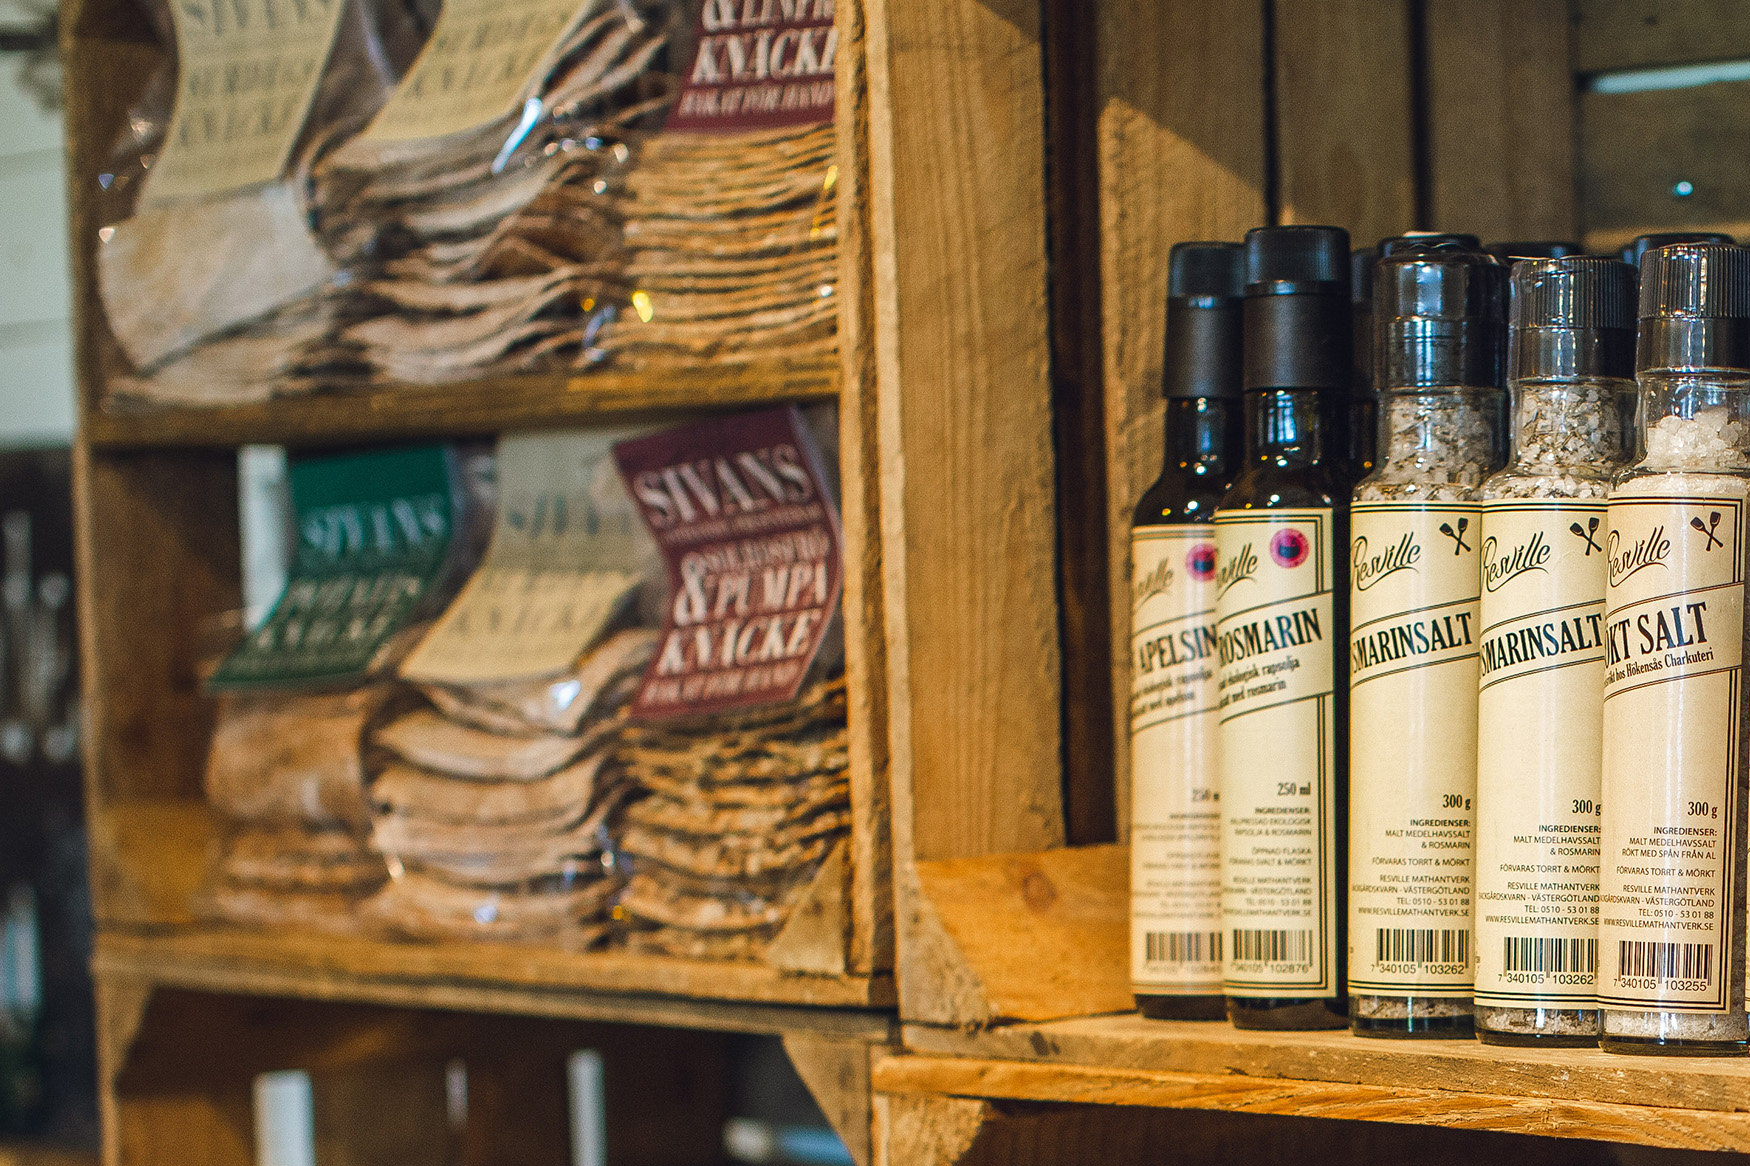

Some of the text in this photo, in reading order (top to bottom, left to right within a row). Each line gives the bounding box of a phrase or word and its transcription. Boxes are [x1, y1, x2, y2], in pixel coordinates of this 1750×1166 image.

[633, 444, 814, 529] SIVANS
[1350, 531, 1421, 592] Resville
[1481, 531, 1550, 592] Resville
[1607, 525, 1671, 588] Resville
[1637, 601, 1708, 655] SALT
[1626, 657, 1664, 678] Hökensås
[1664, 646, 1715, 668] Charkuteri
[1442, 794, 1471, 811] 300 g
[1571, 799, 1601, 816] 300 g
[1687, 801, 1718, 819] 300 g
[1410, 819, 1471, 827] INGREDIENSER:
[1385, 829, 1470, 838] MALT MEDELHAVSSALT
[1538, 825, 1601, 833] INGREDIENSER:
[1653, 826, 1718, 836] INGREDIENSER:
[1429, 841, 1470, 849] ROSMARIN
[1513, 835, 1601, 845] MALT MEDELHAVSSALT
[1629, 837, 1717, 848] MALT MEDELHAVSSALT
[1557, 848, 1601, 856] ROSMARIN
[1622, 848, 1704, 859] RÖKT MED SPÅN FRÅN
[1408, 857, 1470, 867] TORRT MÖRKT
[1500, 863, 1600, 874] FÖRVARAS TORRT MÖRKT
[1616, 865, 1716, 878] FÖRVARAS TORRT MÖRKT
[1411, 875, 1470, 884] MATHANTVERK
[1403, 885, 1470, 895] VÄSTERGÖTLAND
[1507, 882, 1600, 892] RESVILLE MATHANTVERK
[1622, 884, 1716, 896] RESVILLE MATHANTVERK
[1412, 897, 1432, 905] 0510
[1531, 893, 1600, 903] VÄSTERGÖTLAND
[1645, 896, 1715, 908] VÄSTERGÖTLAND
[1541, 905, 1560, 914] 0510
[1654, 909, 1674, 918] 0510
[1380, 963, 1465, 975] 340105 103262
[1507, 973, 1594, 985] 340105 103262
[1620, 978, 1707, 992] 340105 103255
